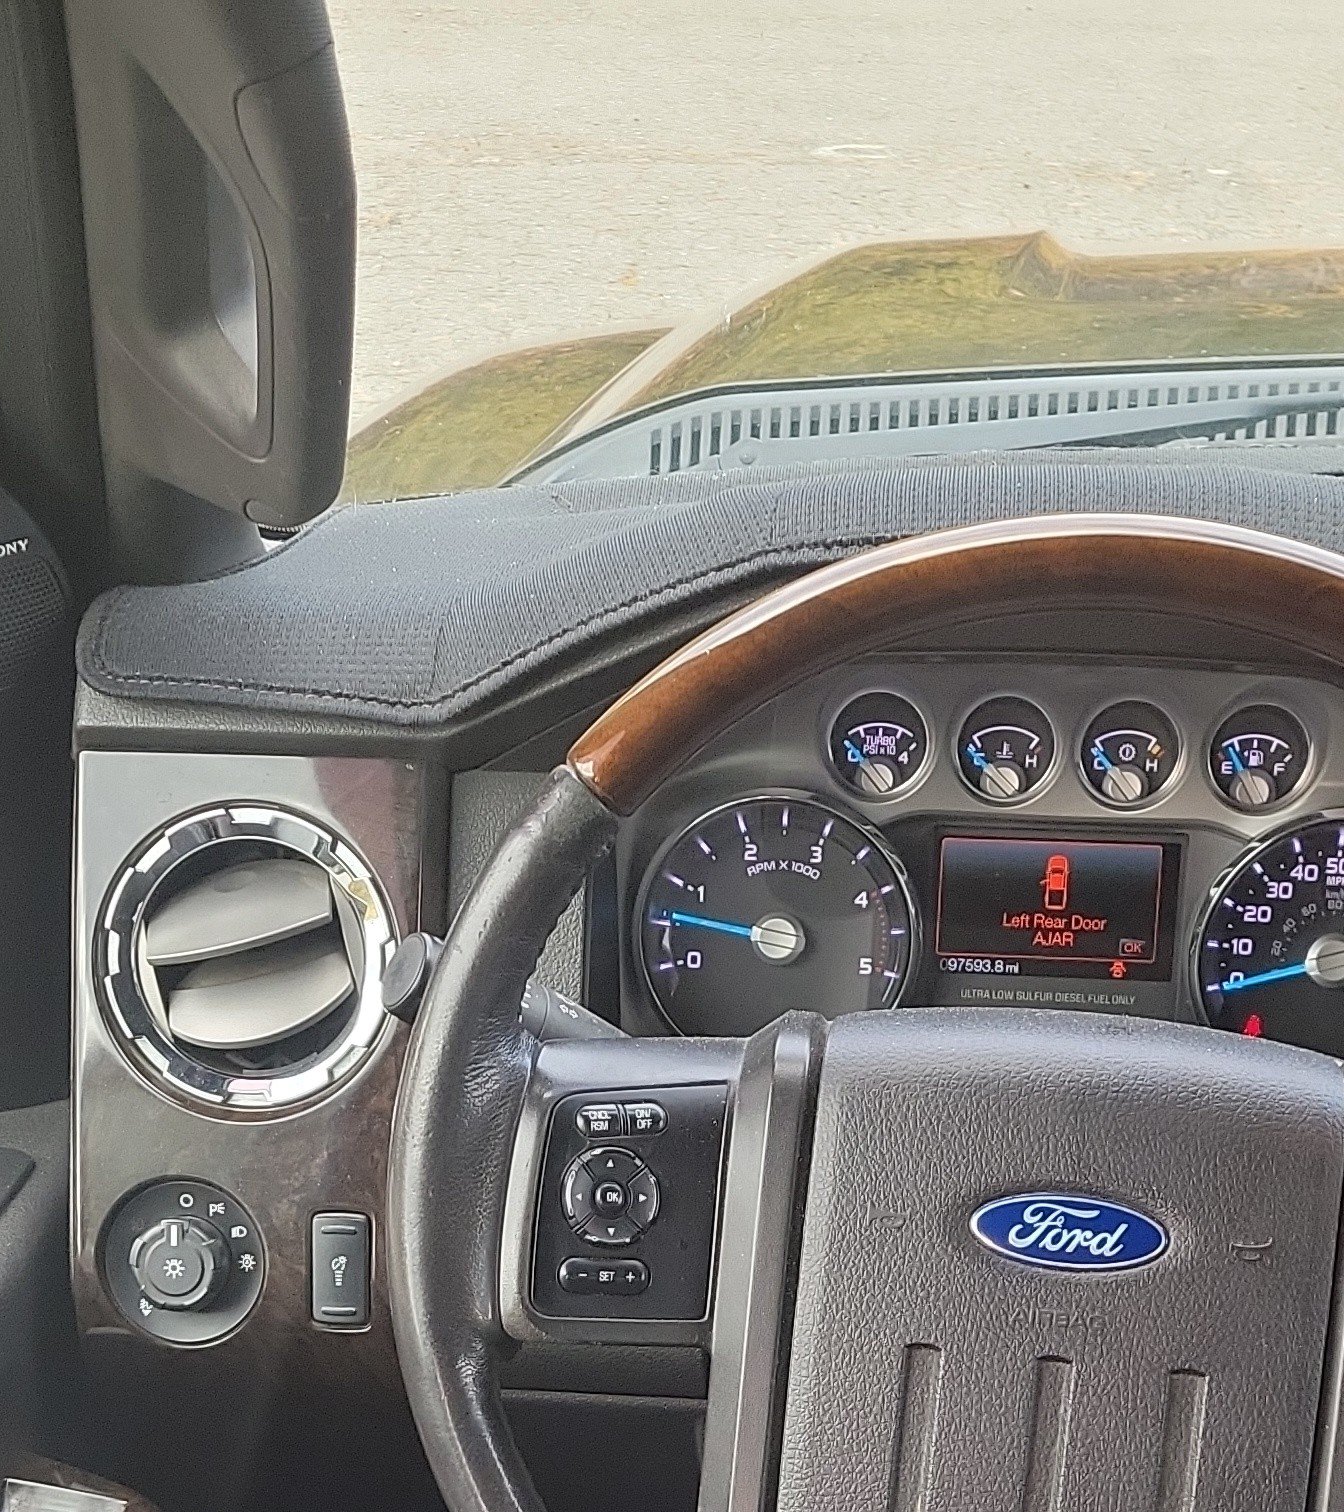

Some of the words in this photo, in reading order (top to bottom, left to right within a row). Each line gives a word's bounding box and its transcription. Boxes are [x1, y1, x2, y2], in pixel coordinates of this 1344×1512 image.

[865, 736, 896, 746] TURBO
[862, 745, 878, 754] PSI
[886, 745, 896, 755] 10
[898, 752, 909, 764] 4
[1025, 755, 1037, 768] H
[1146, 760, 1158, 772] H
[1222, 762, 1233, 774] E
[1274, 763, 1286, 776] F
[744, 844, 757, 861] 2
[810, 846, 822, 863] 3
[747, 861, 776, 877] RPM
[791, 862, 821, 880] 1000
[1290, 864, 1319, 881] 40
[697, 886, 704, 902] 1
[1266, 882, 1293, 899] 30
[854, 891, 868, 908] 4
[1003, 913, 1030, 929] Left
[1034, 914, 1067, 929] Rear
[1072, 915, 1107, 930] Door
[1243, 905, 1272, 923] 20
[1033, 932, 1074, 947] AJAR
[1123, 942, 1143, 953] OK
[1231, 938, 1253, 955] 10
[687, 951, 701, 969] 0
[859, 958, 872, 975] 5
[961, 989, 991, 1000] ULTRA
[992, 990, 1014, 1001] LOW
[1016, 990, 1053, 1002] SULFUR
[1055, 992, 1085, 1003] DIESEL
[1088, 994, 1108, 1004] FUEL
[1111, 995, 1136, 1005] ONLY
[590, 1121, 609, 1131] RSM
[636, 1119, 653, 1130] OFF
[606, 1191, 619, 1202] OK
[1008, 1202, 1128, 1257] Ford
[599, 1271, 616, 1282] SET
